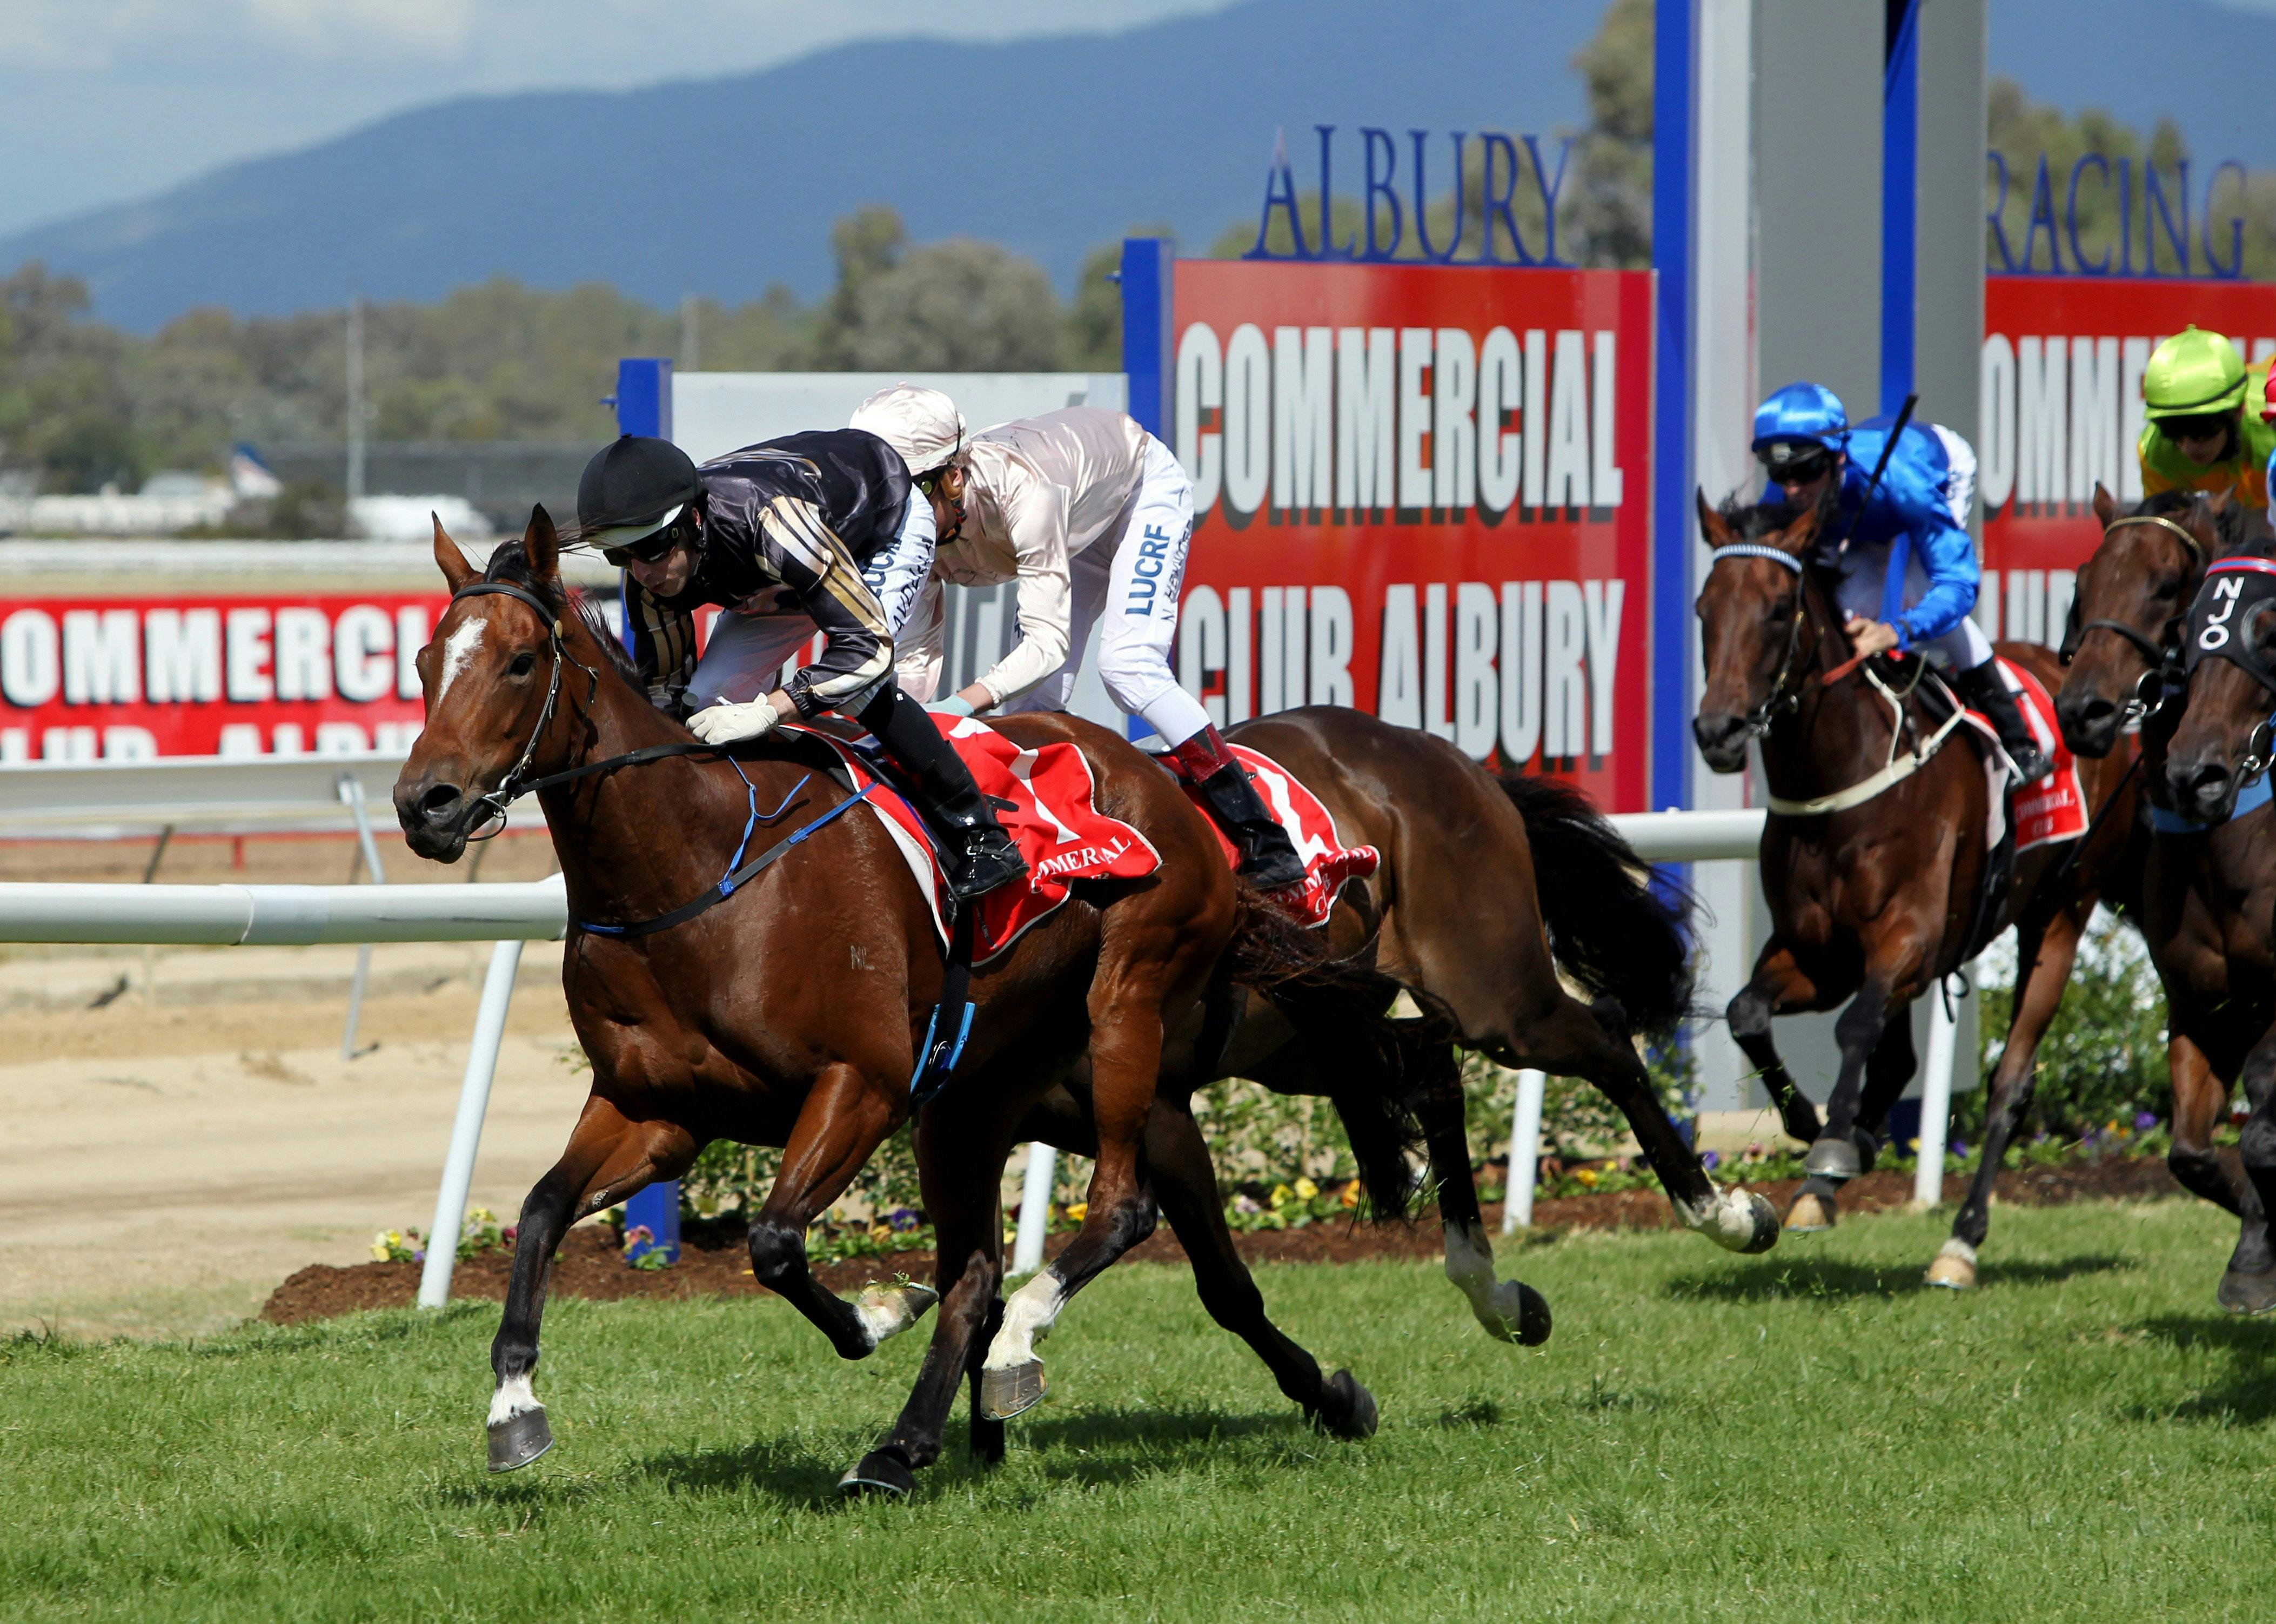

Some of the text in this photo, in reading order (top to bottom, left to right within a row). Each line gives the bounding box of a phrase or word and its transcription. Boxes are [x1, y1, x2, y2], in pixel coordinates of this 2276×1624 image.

[1242, 124, 1575, 267] ALBURY
[1176, 322, 1623, 513] COMMERCIAL
[1125, 524, 1170, 616] LUCRF
[1, 605, 432, 707] OMMERCI
[1379, 579, 1625, 764] ALBURY
